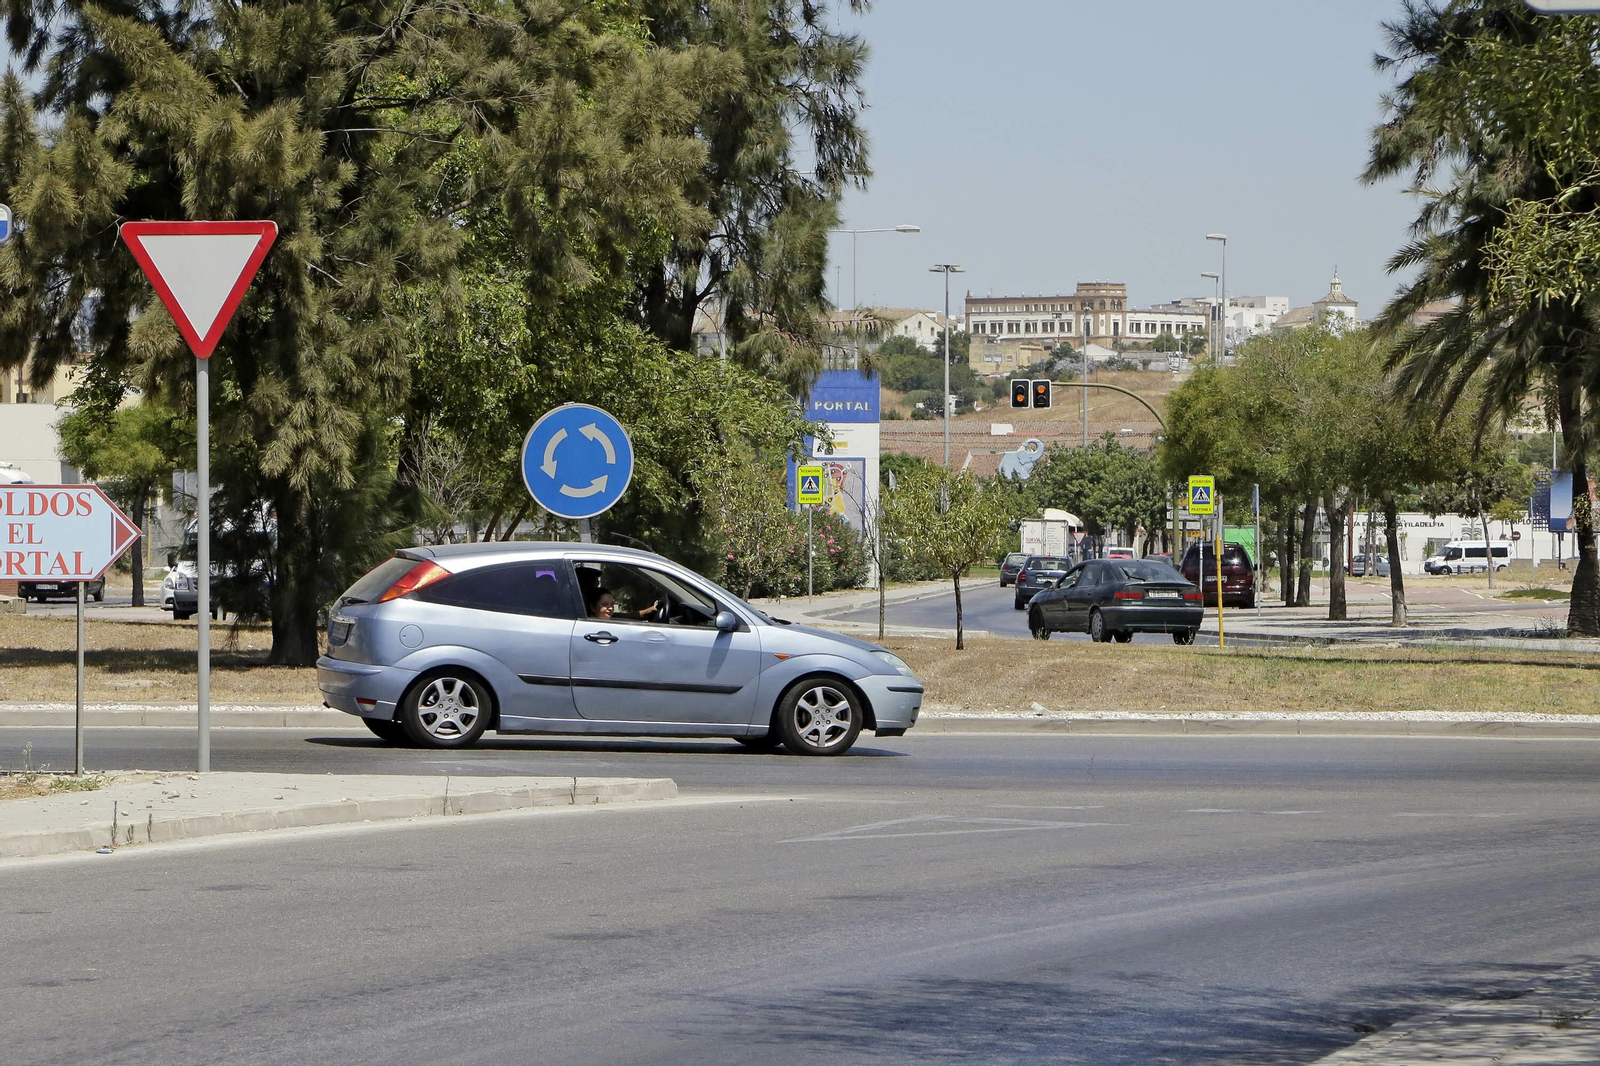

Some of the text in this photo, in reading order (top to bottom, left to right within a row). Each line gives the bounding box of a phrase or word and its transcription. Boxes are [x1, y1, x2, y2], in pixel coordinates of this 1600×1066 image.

[814, 401, 872, 411] PORTAL
[0, 491, 93, 517] LDOS
[7, 523, 44, 544] EL
[0, 551, 94, 576] RTAL
